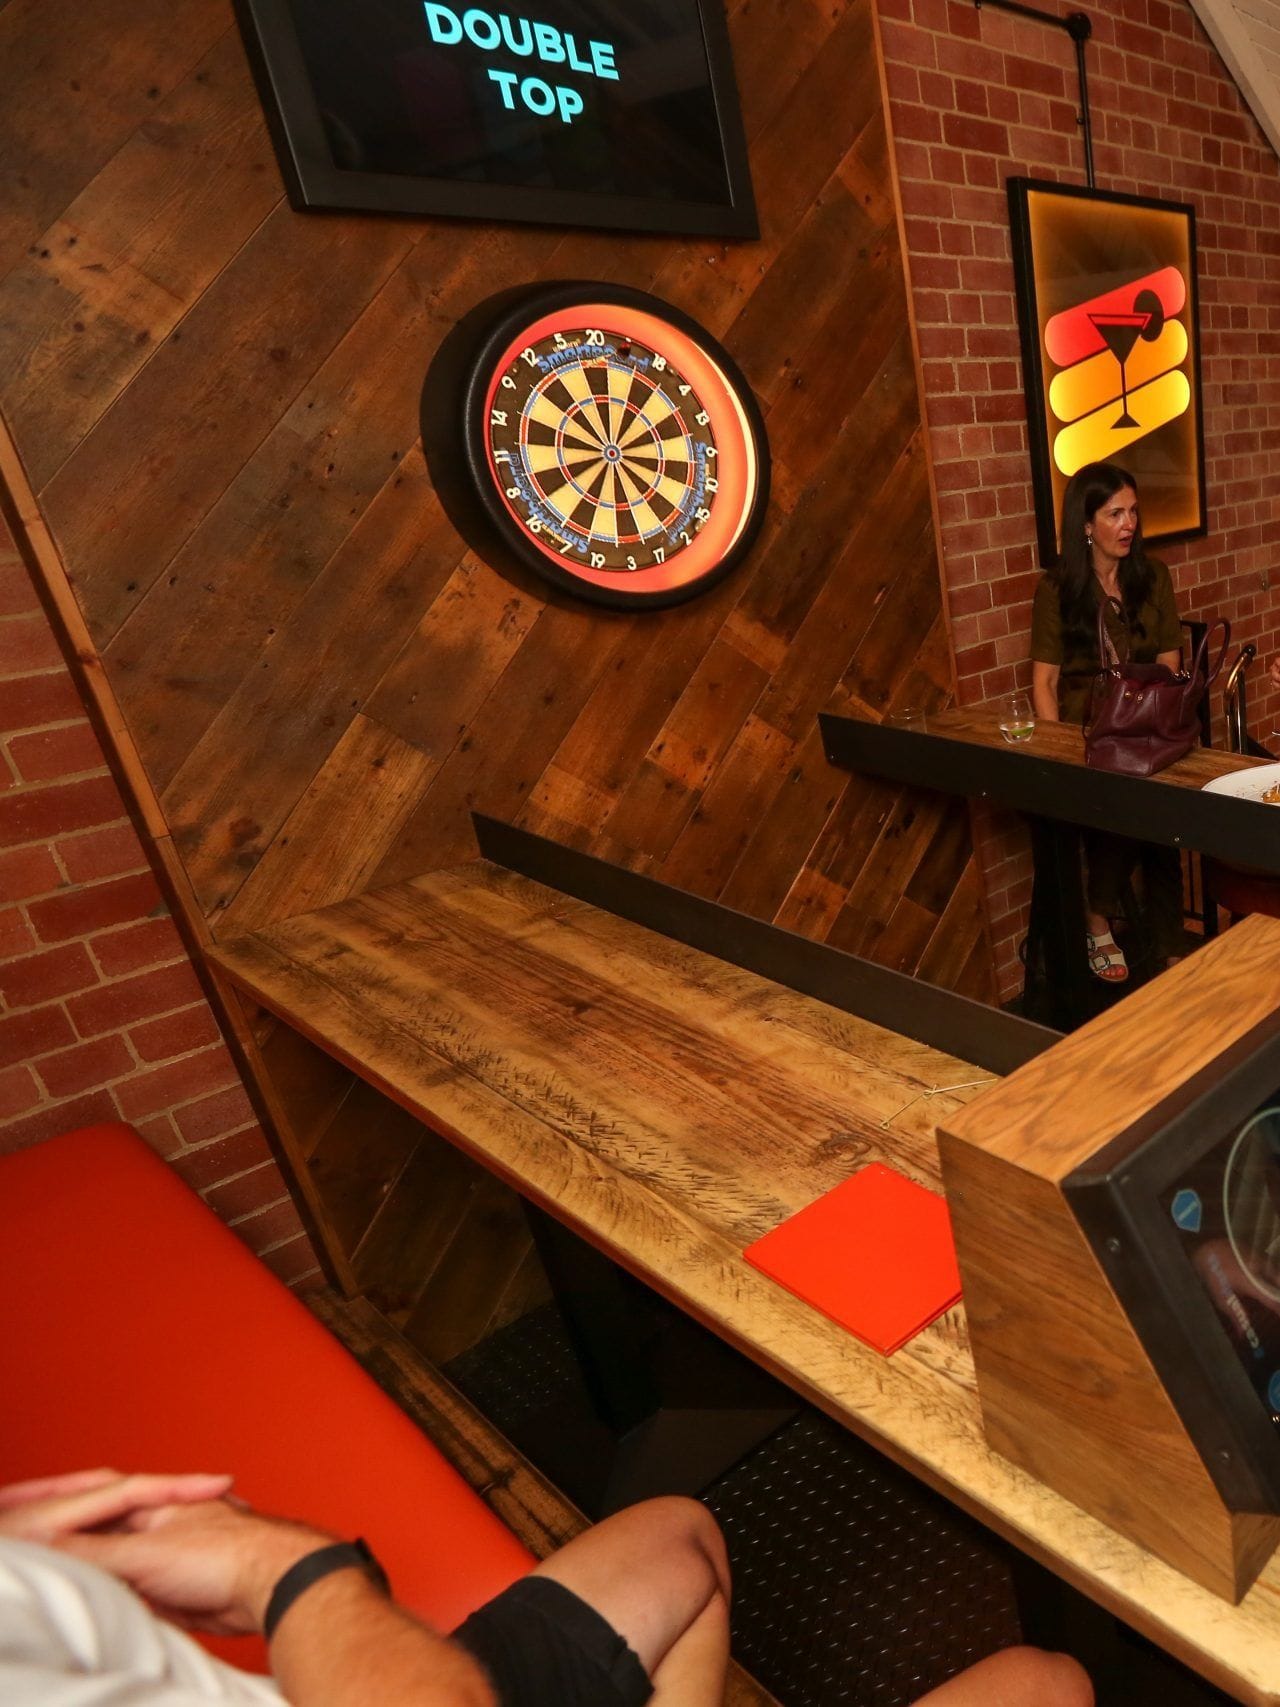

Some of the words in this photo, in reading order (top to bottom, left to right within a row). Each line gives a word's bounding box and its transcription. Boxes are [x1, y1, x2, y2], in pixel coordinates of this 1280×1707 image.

[423, 2, 620, 81] DOUBLE
[487, 69, 585, 125] TOP
[554, 333, 568, 349] 5
[585, 329, 605, 346] 20
[521, 348, 540, 368] 12
[652, 353, 667, 372] 18
[501, 375, 517, 390] 9
[678, 385, 691, 396] 4
[491, 410, 508, 426] 14
[695, 409, 710, 426] 13
[506, 486, 521, 499] 8
[705, 477, 719, 493] 10
[526, 513, 542, 533] 16
[695, 507, 710, 523] 15
[680, 531, 692, 546] 2
[559, 541, 573, 554] 7
[652, 547, 666, 564] 17
[590, 552, 606, 568] 19
[626, 555, 637, 570] 3
